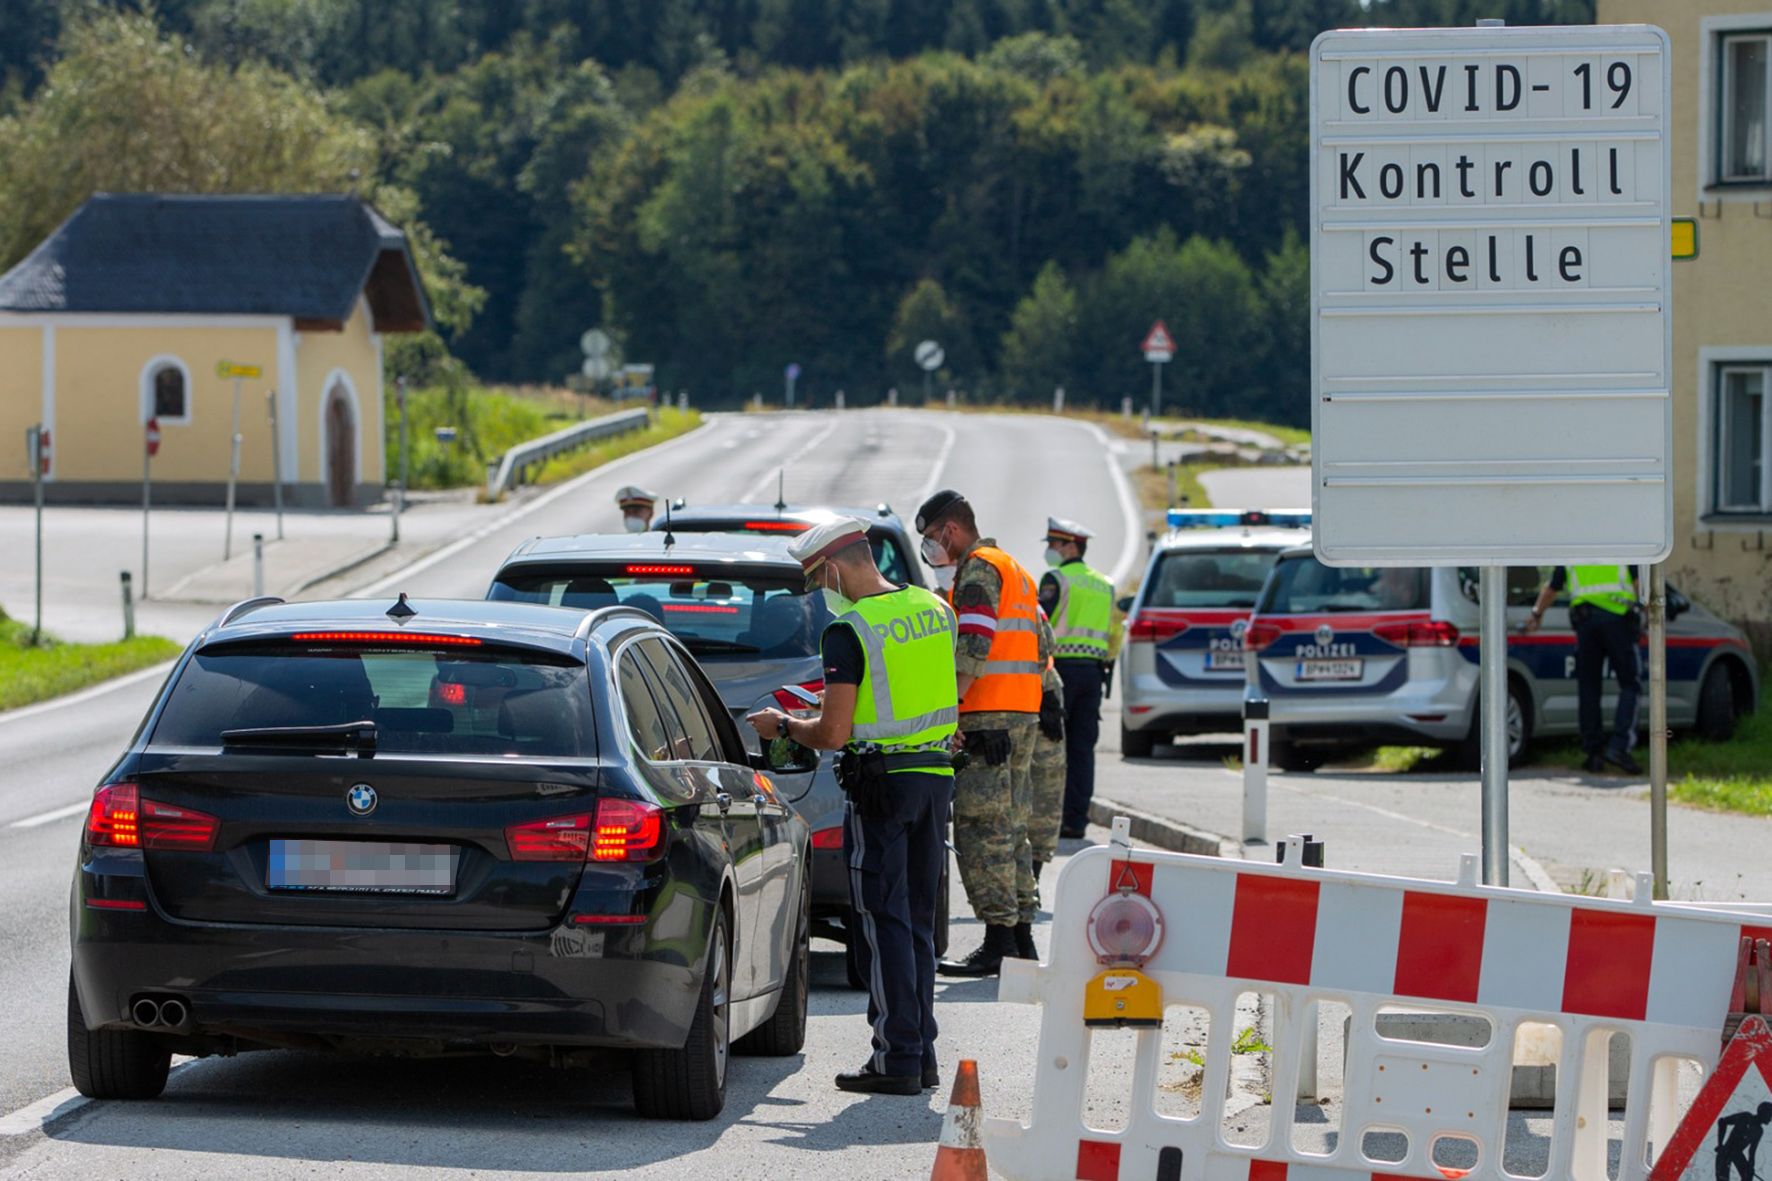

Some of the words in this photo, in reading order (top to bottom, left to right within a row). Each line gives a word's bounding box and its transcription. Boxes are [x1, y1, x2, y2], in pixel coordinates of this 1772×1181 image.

[1347, 61, 1632, 115] COVID-19
[1339, 147, 1623, 200] Kontroll
[1368, 234, 1583, 286] Stelle
[872, 608, 952, 649] POLIZE
[1296, 643, 1356, 659] POLIZEI
